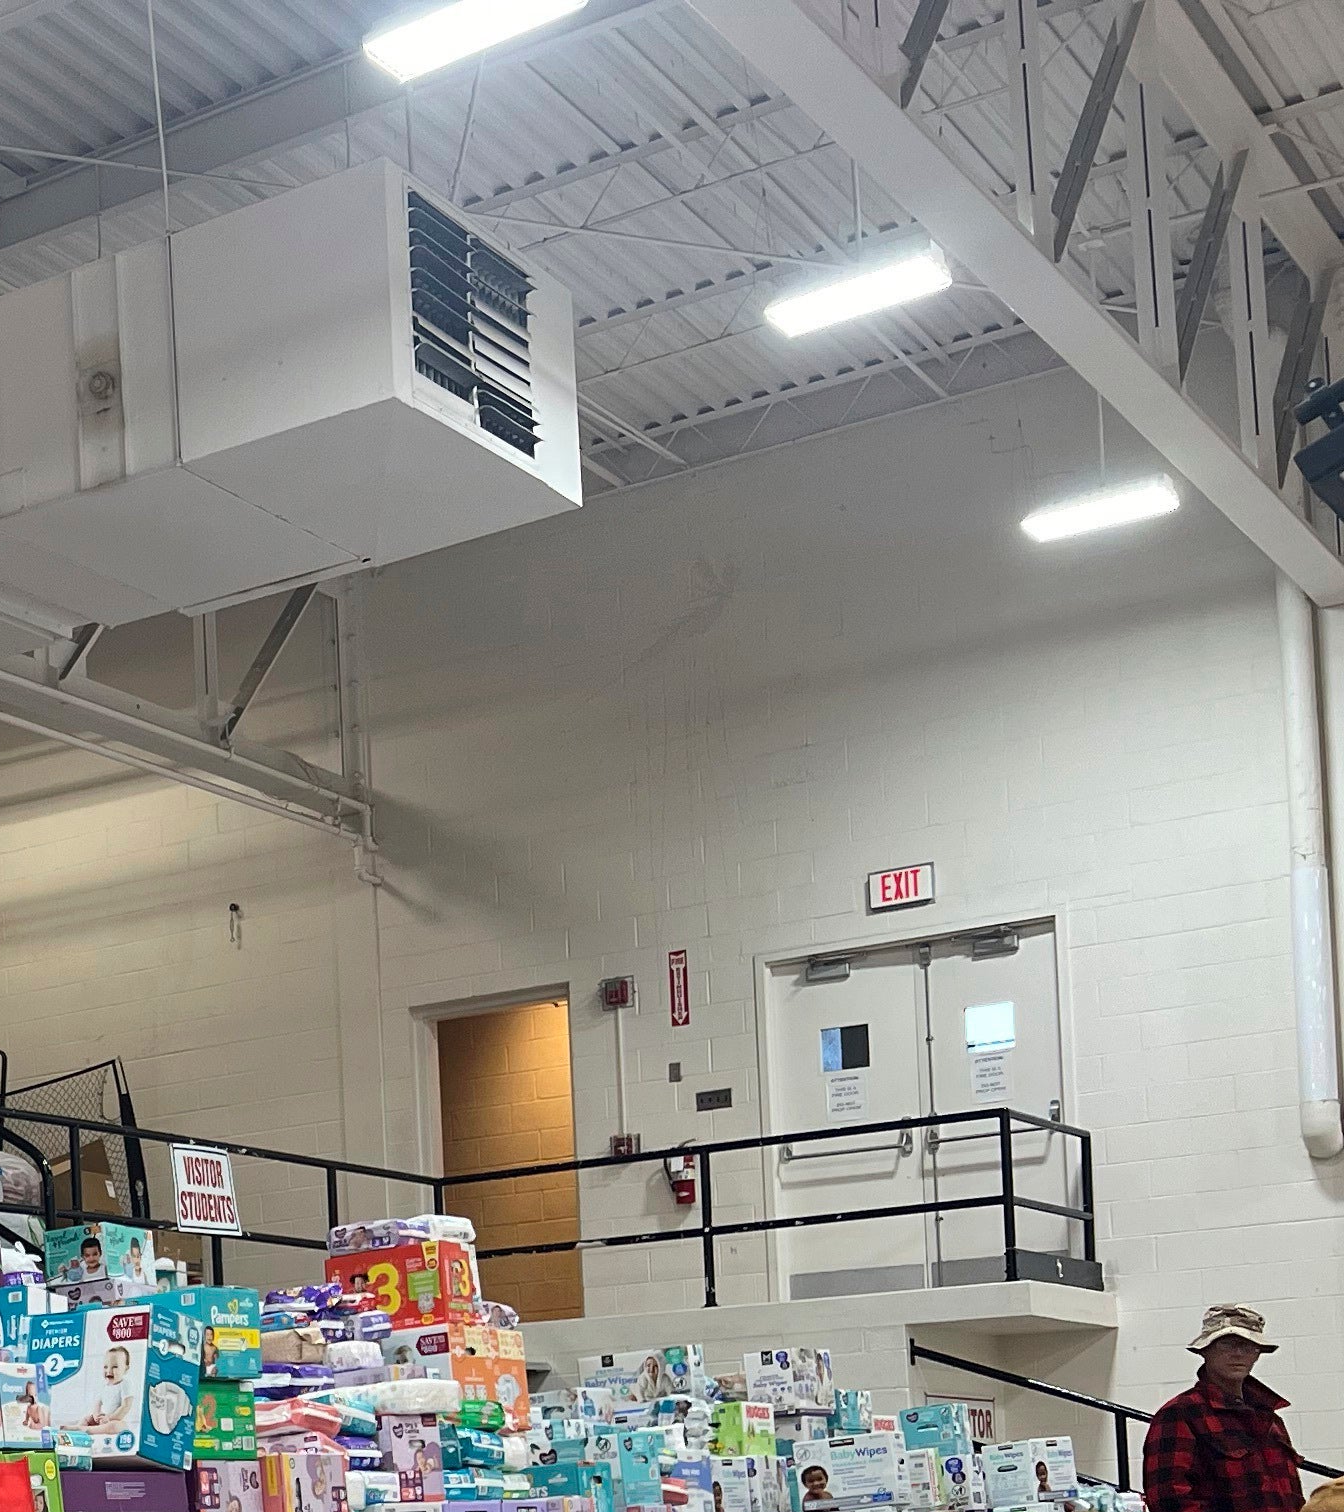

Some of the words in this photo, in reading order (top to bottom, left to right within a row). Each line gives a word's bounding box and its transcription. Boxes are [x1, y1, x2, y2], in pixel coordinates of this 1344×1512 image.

[881, 869, 921, 902] EXIT
[183, 1156, 224, 1189] VISITOR
[181, 1191, 234, 1224] STUDENTS
[367, 1262, 401, 1315] 3
[112, 1317, 135, 1328] SAVE
[211, 1306, 249, 1327] Pampers
[32, 1335, 80, 1350] DIAPERS
[50, 1357, 59, 1372] 2
[585, 1377, 605, 1389] Baby
[607, 1376, 638, 1387] Wipes
[830, 1449, 854, 1460] Baby
[855, 1445, 887, 1459] Wipes
